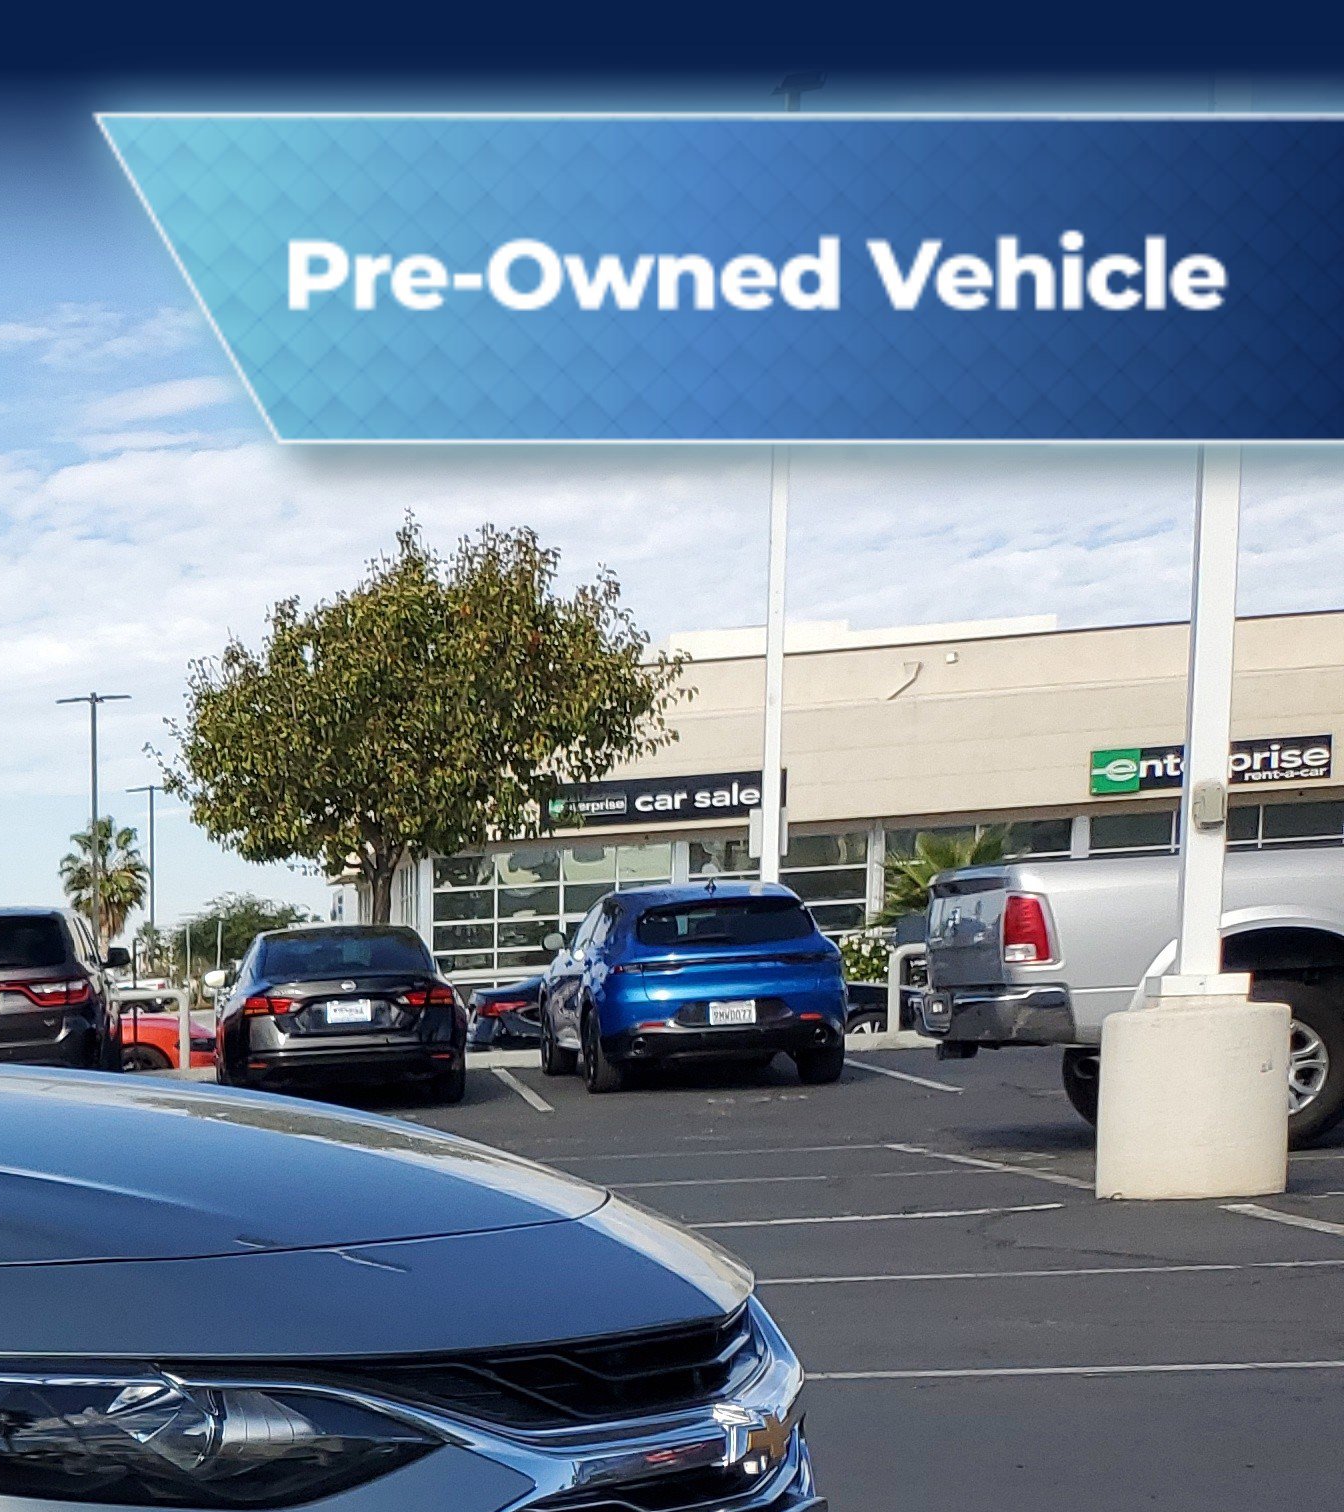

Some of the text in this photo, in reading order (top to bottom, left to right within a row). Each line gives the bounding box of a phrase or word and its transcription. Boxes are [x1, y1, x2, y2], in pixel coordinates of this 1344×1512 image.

[1092, 744, 1330, 782] entprise
[1243, 765, 1328, 781] rent-a-car
[634, 791, 688, 812] car
[693, 781, 761, 808] sale
